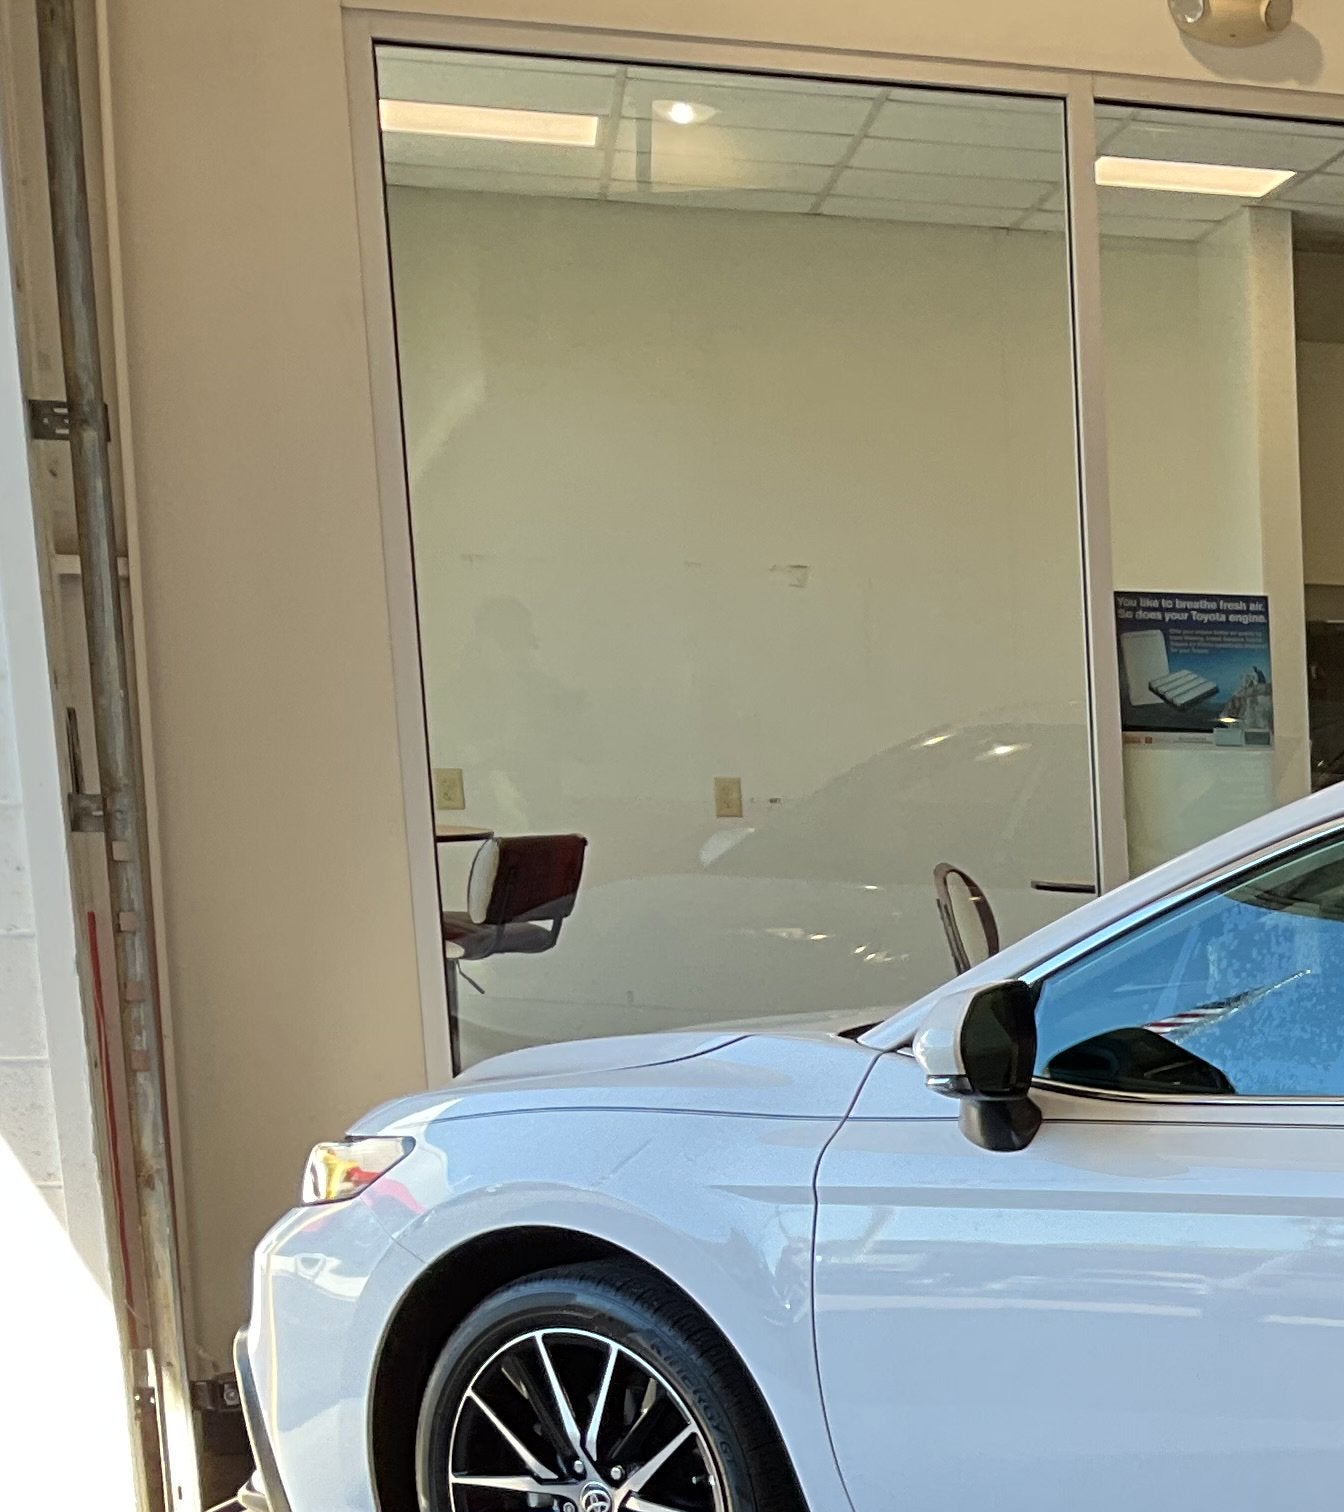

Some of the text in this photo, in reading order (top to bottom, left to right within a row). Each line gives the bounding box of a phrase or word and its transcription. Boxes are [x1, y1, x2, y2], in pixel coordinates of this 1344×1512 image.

[1117, 598, 1264, 611] You like to breathe fresh air.
[1117, 609, 1268, 625] So does your Toyota engine.
